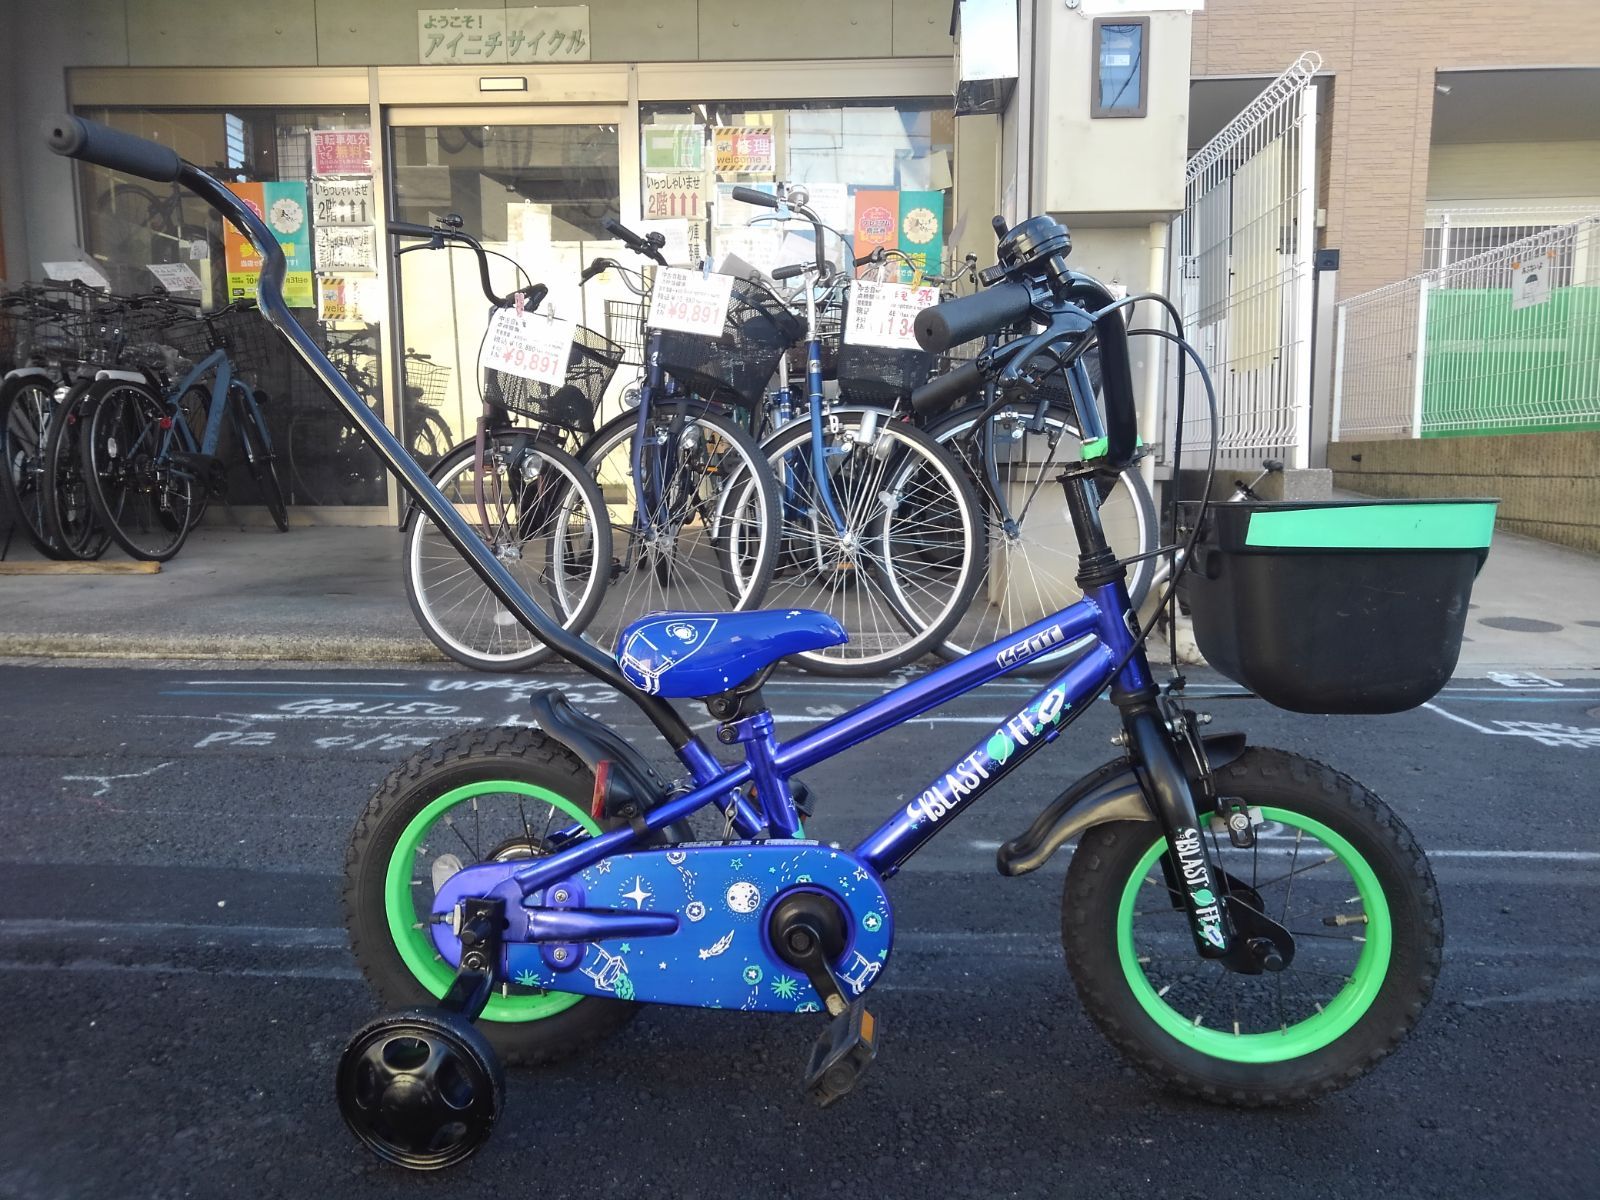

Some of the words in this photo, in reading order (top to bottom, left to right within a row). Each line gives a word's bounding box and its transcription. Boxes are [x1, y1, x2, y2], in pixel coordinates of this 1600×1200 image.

[425, 30, 586, 58] アイニチサイクル
[315, 134, 369, 146] 自転車処分
[736, 138, 770, 155] 修理
[717, 155, 761, 164] welcome
[315, 184, 368, 196] いらっしゃいませ
[646, 176, 701, 190] いらっしゃいませ
[648, 192, 667, 217] 2階
[502, 346, 559, 376] ¥9,891
[917, 750, 990, 822] BLAST
[1175, 837, 1210, 886] BLAST
